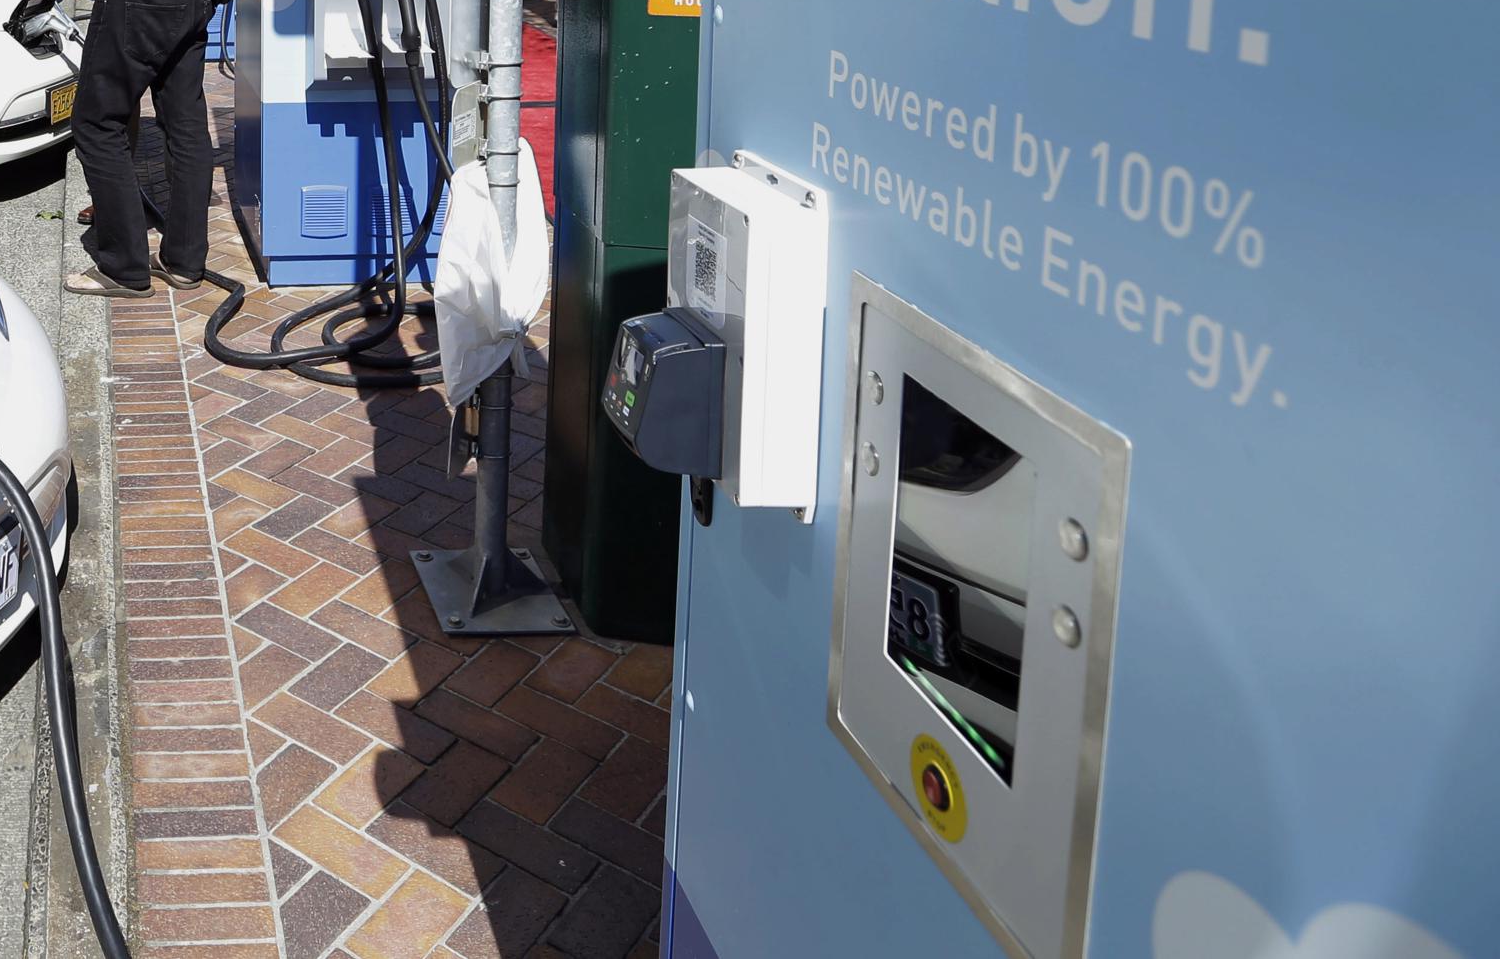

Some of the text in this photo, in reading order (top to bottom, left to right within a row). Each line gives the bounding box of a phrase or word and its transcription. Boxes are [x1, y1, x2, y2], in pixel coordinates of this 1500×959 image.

[811, 122, 1288, 409] Renewable Energy.
[828, 50, 1264, 268] Powered by 100%
